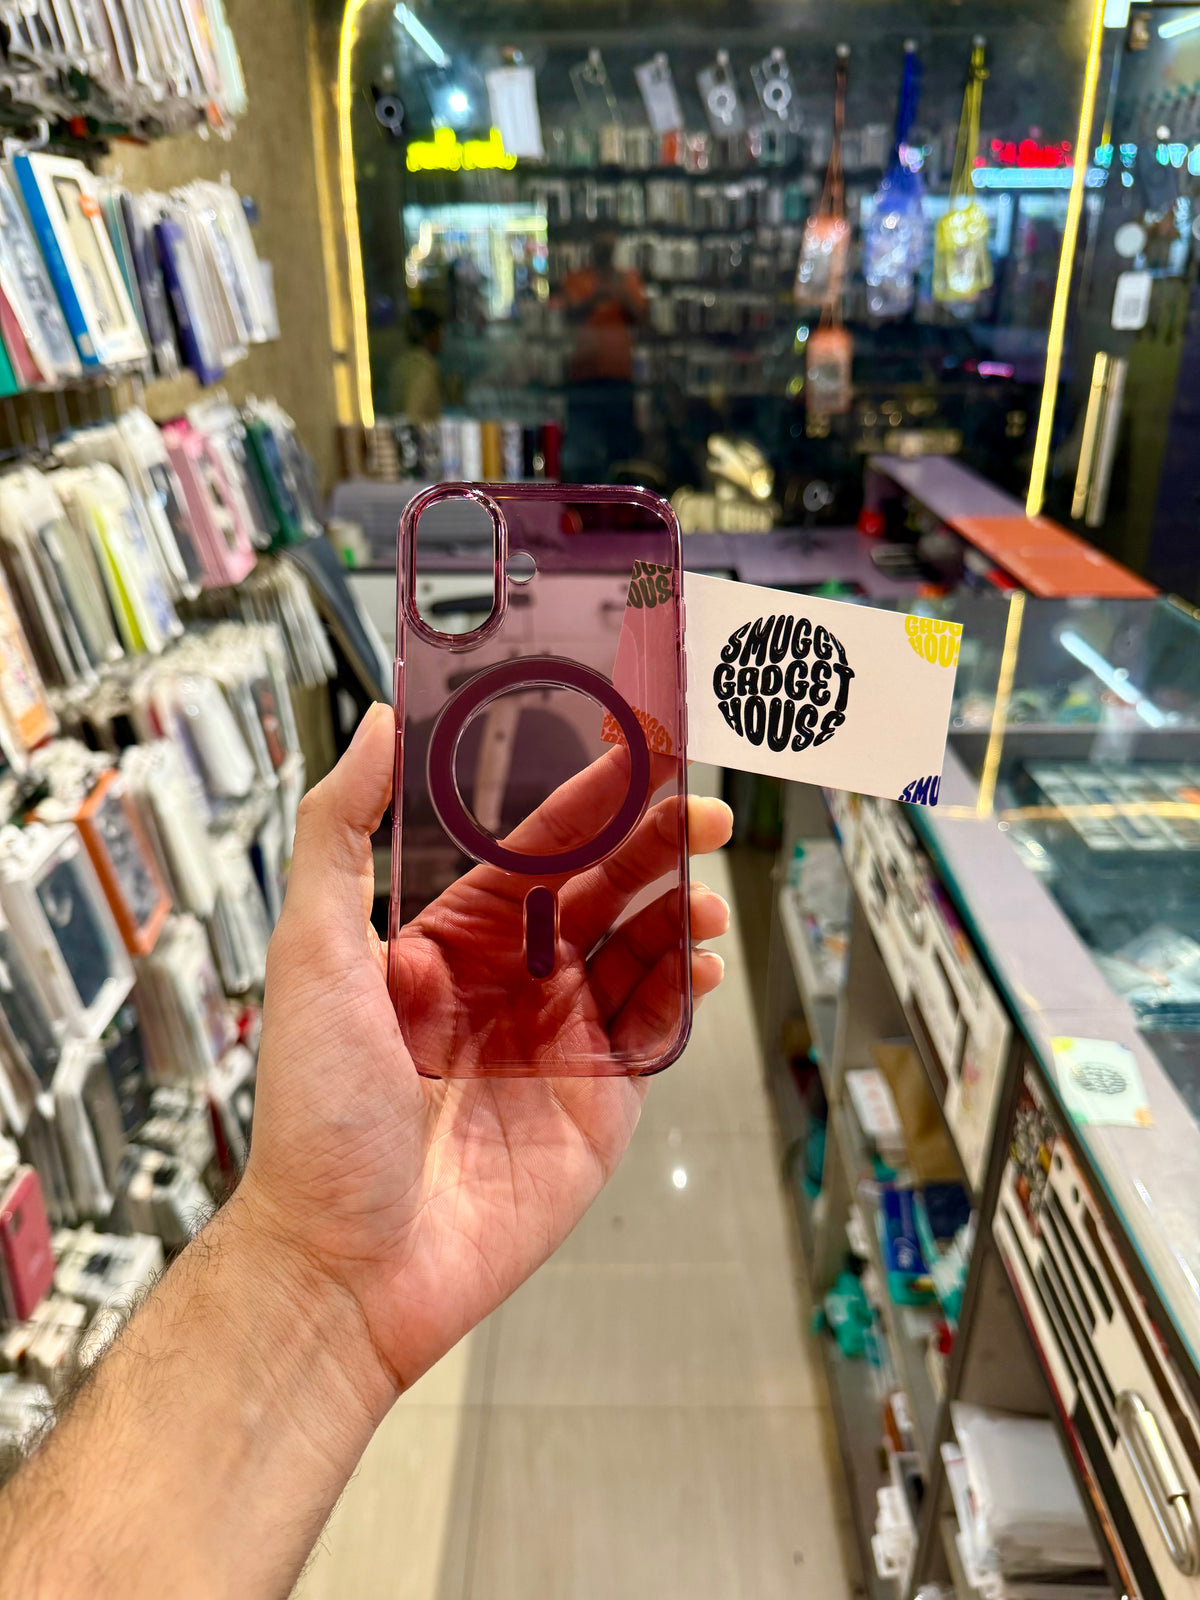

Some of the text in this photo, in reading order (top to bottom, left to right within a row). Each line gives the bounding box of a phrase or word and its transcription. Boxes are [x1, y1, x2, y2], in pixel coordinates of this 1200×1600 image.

[720, 614, 848, 667] SMUGGY
[712, 659, 855, 712] GADGET
[717, 695, 846, 753] HOUSE
[898, 775, 941, 807] SMU
